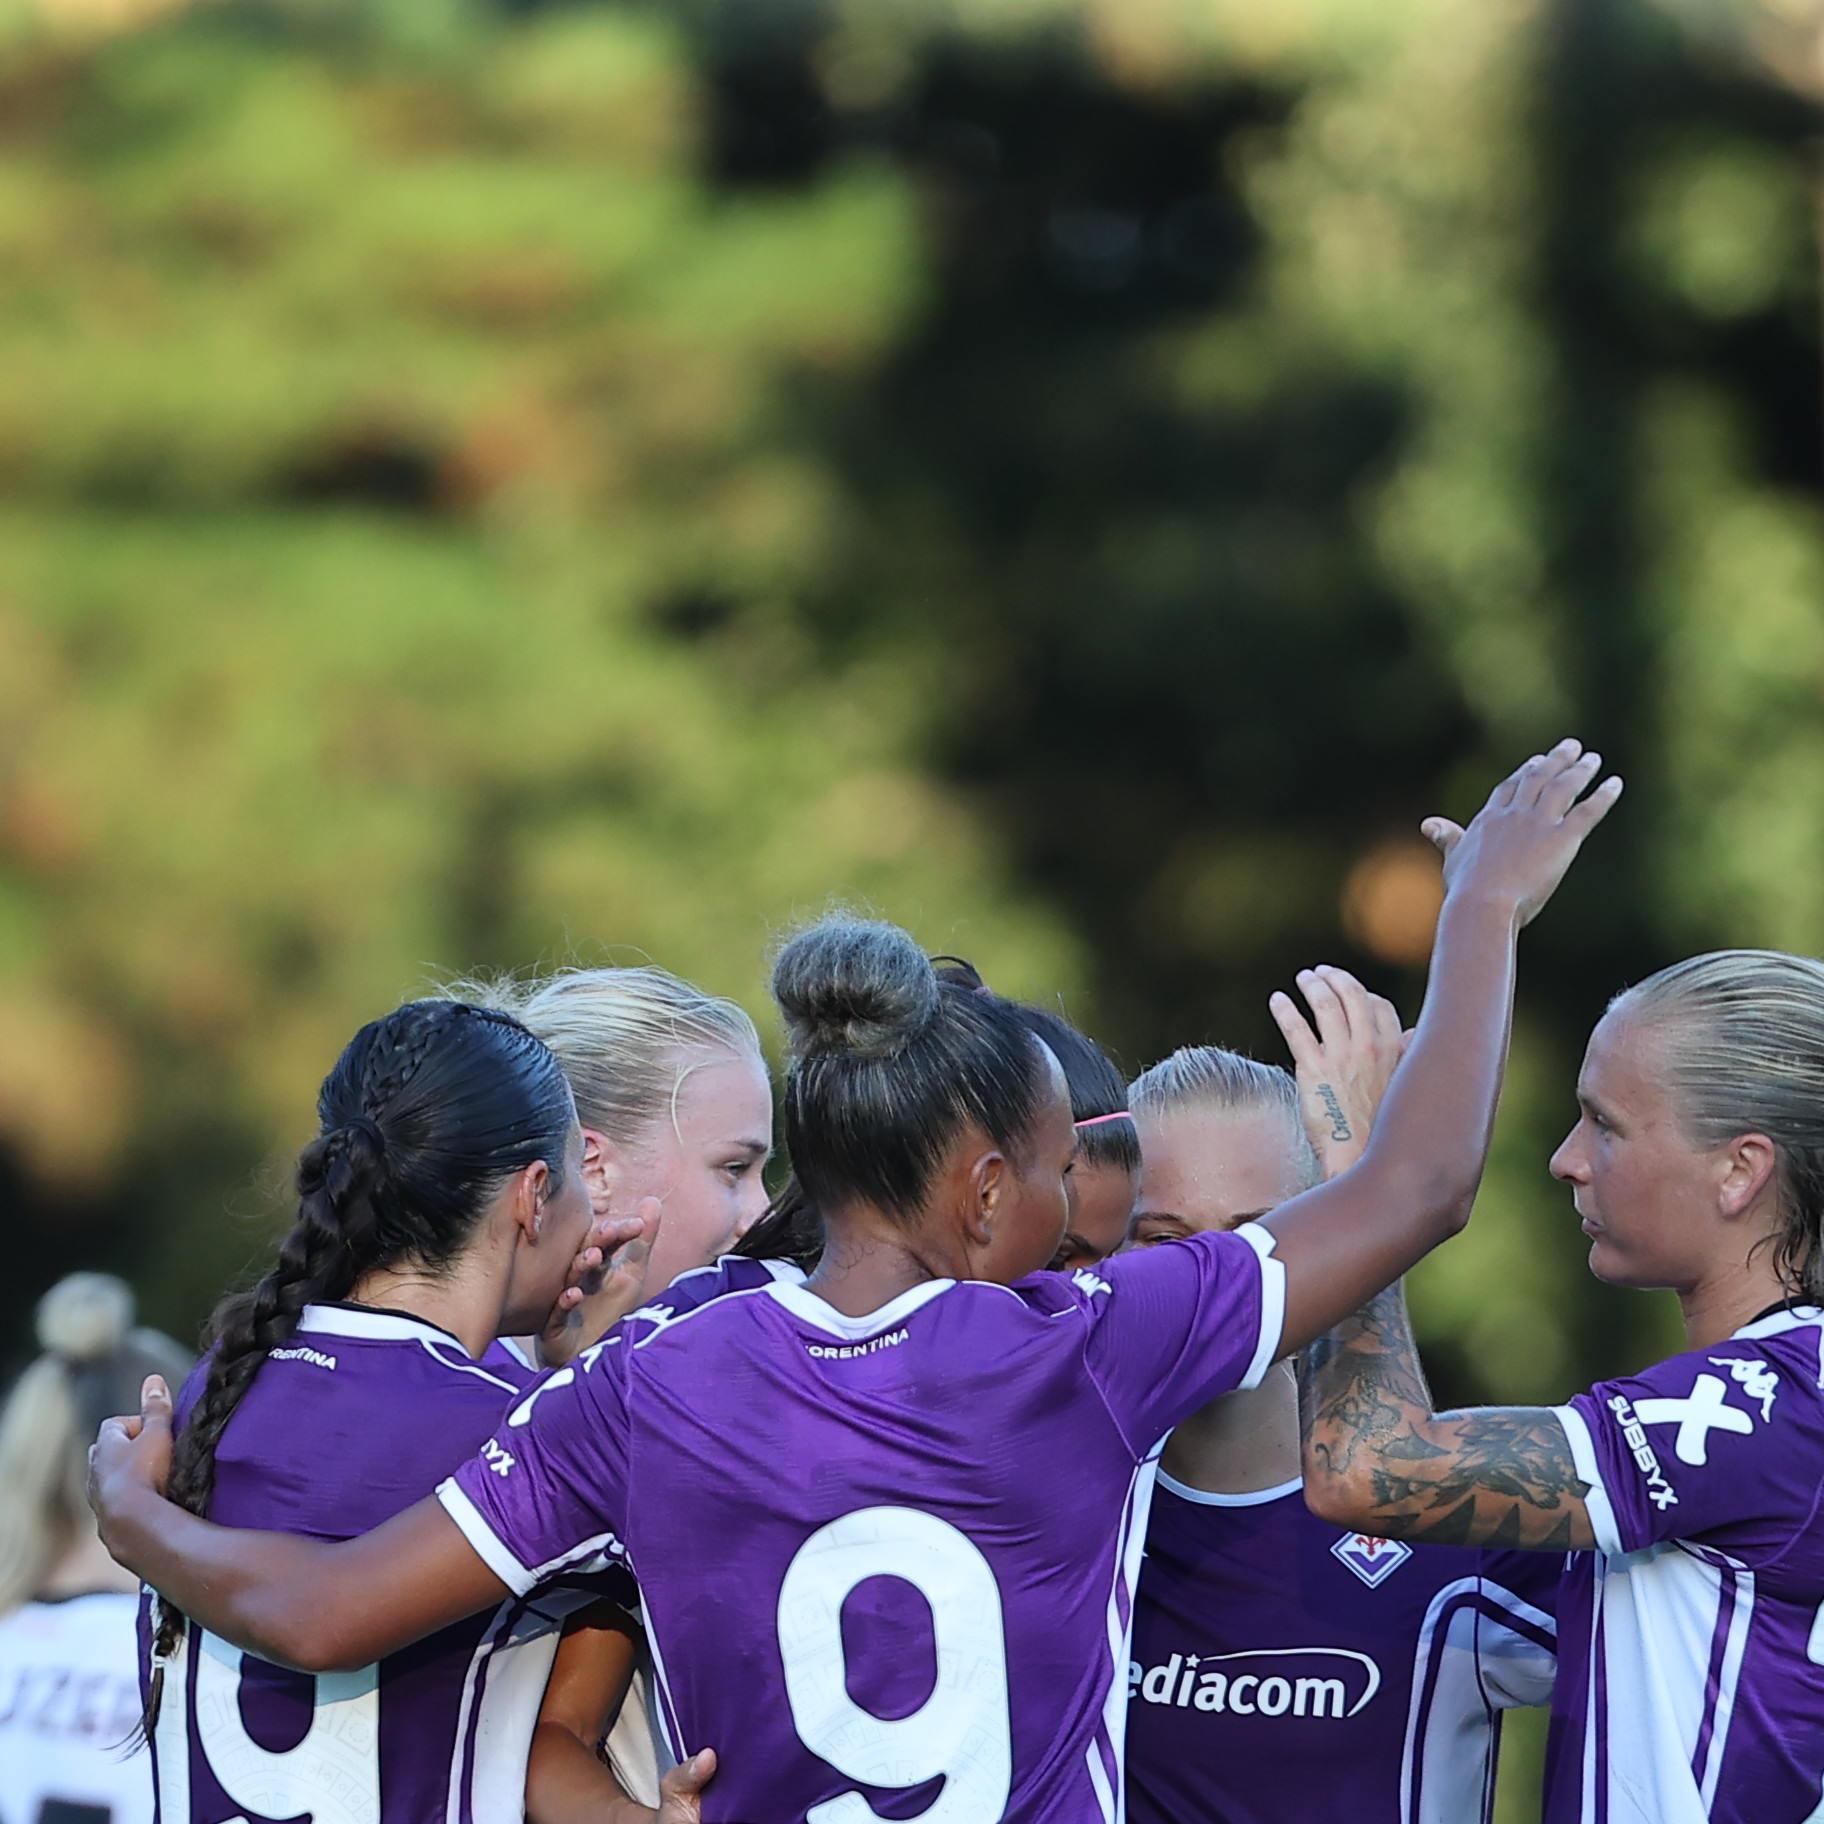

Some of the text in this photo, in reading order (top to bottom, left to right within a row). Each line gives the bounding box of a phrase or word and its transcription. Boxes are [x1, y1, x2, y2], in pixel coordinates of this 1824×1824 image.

[267, 1345, 337, 1371] RENTINA
[804, 1327, 909, 1360] ORENTINA
[1606, 1394, 1680, 1512] SUBBYX
[1128, 1652, 1347, 1719] ediacom
